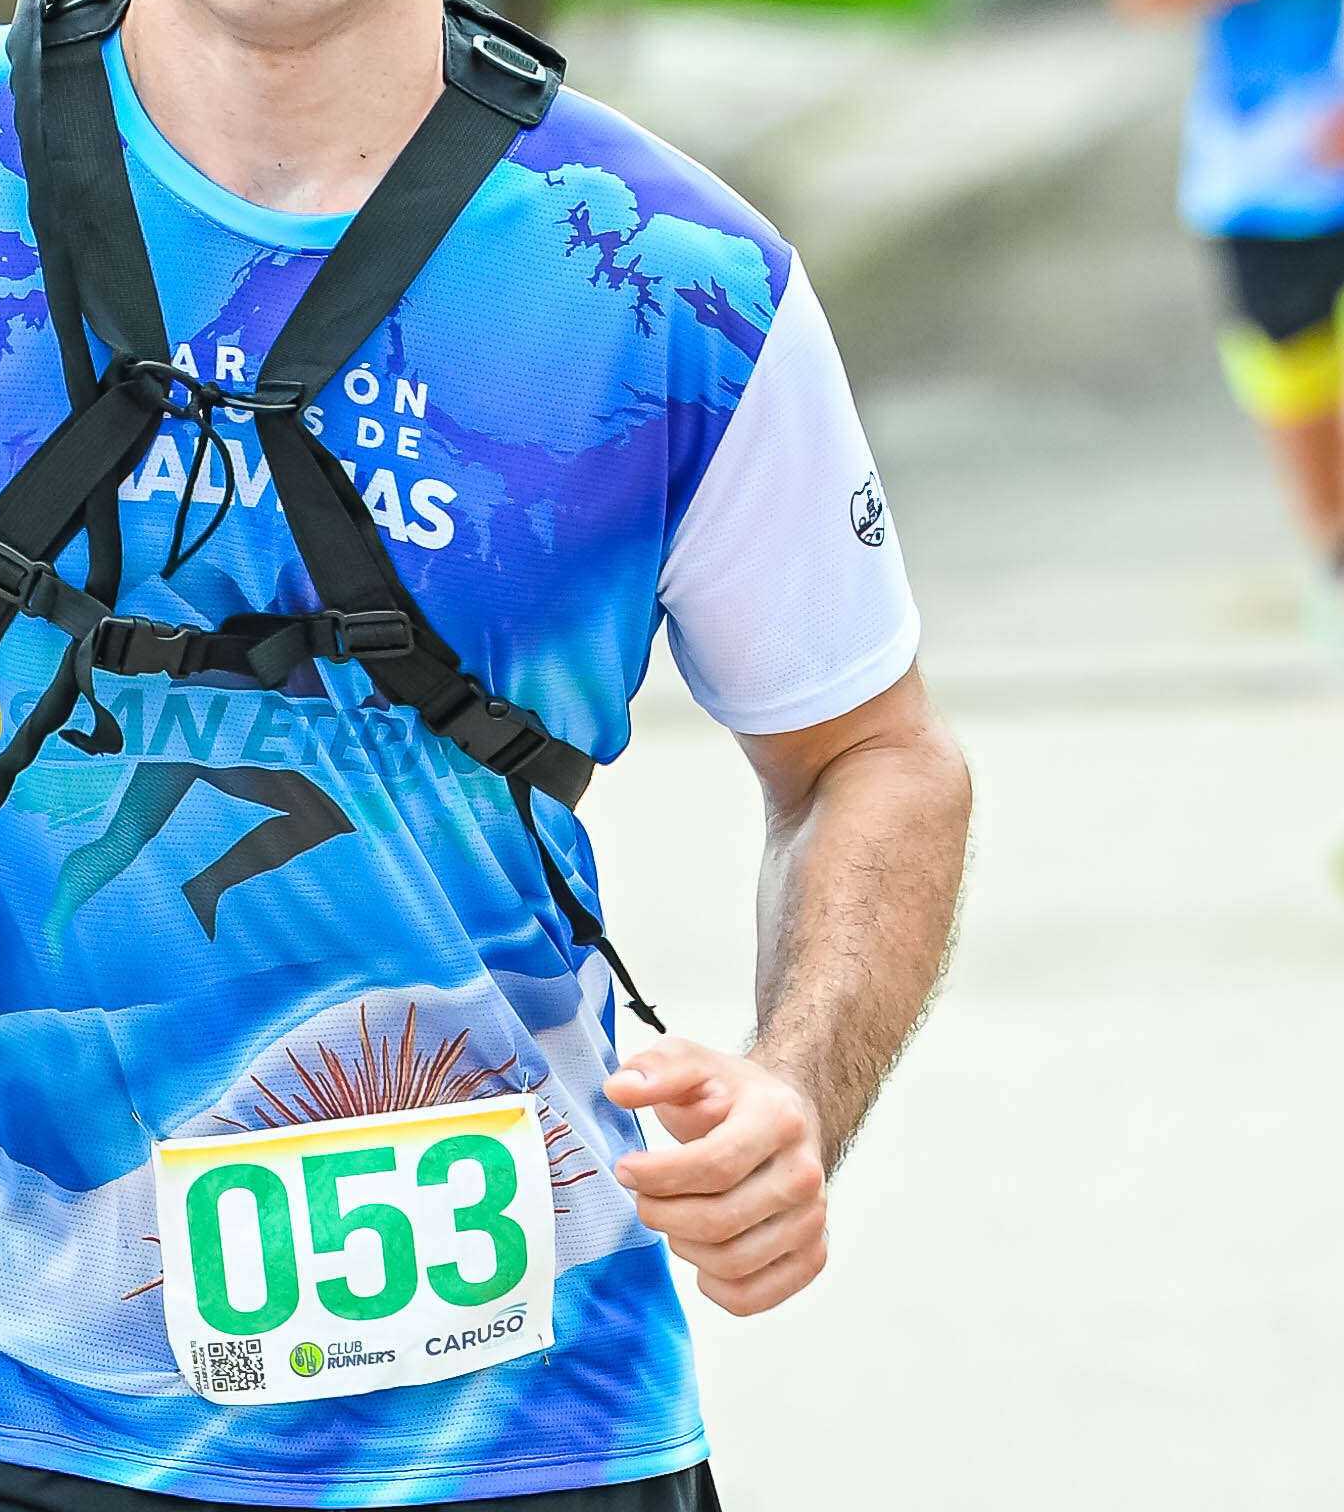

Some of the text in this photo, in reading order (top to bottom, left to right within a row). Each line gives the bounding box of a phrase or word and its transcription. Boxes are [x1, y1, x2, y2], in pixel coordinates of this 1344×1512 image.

[171, 342, 429, 420] ARÓN
[357, 413, 421, 461] DE
[117, 433, 458, 551] ALVAS
[185, 1134, 529, 1336] 053
[327, 1340, 363, 1356] CLUB
[425, 1314, 524, 1357] CARUSO
[327, 1350, 396, 1370] RUNNER'S
